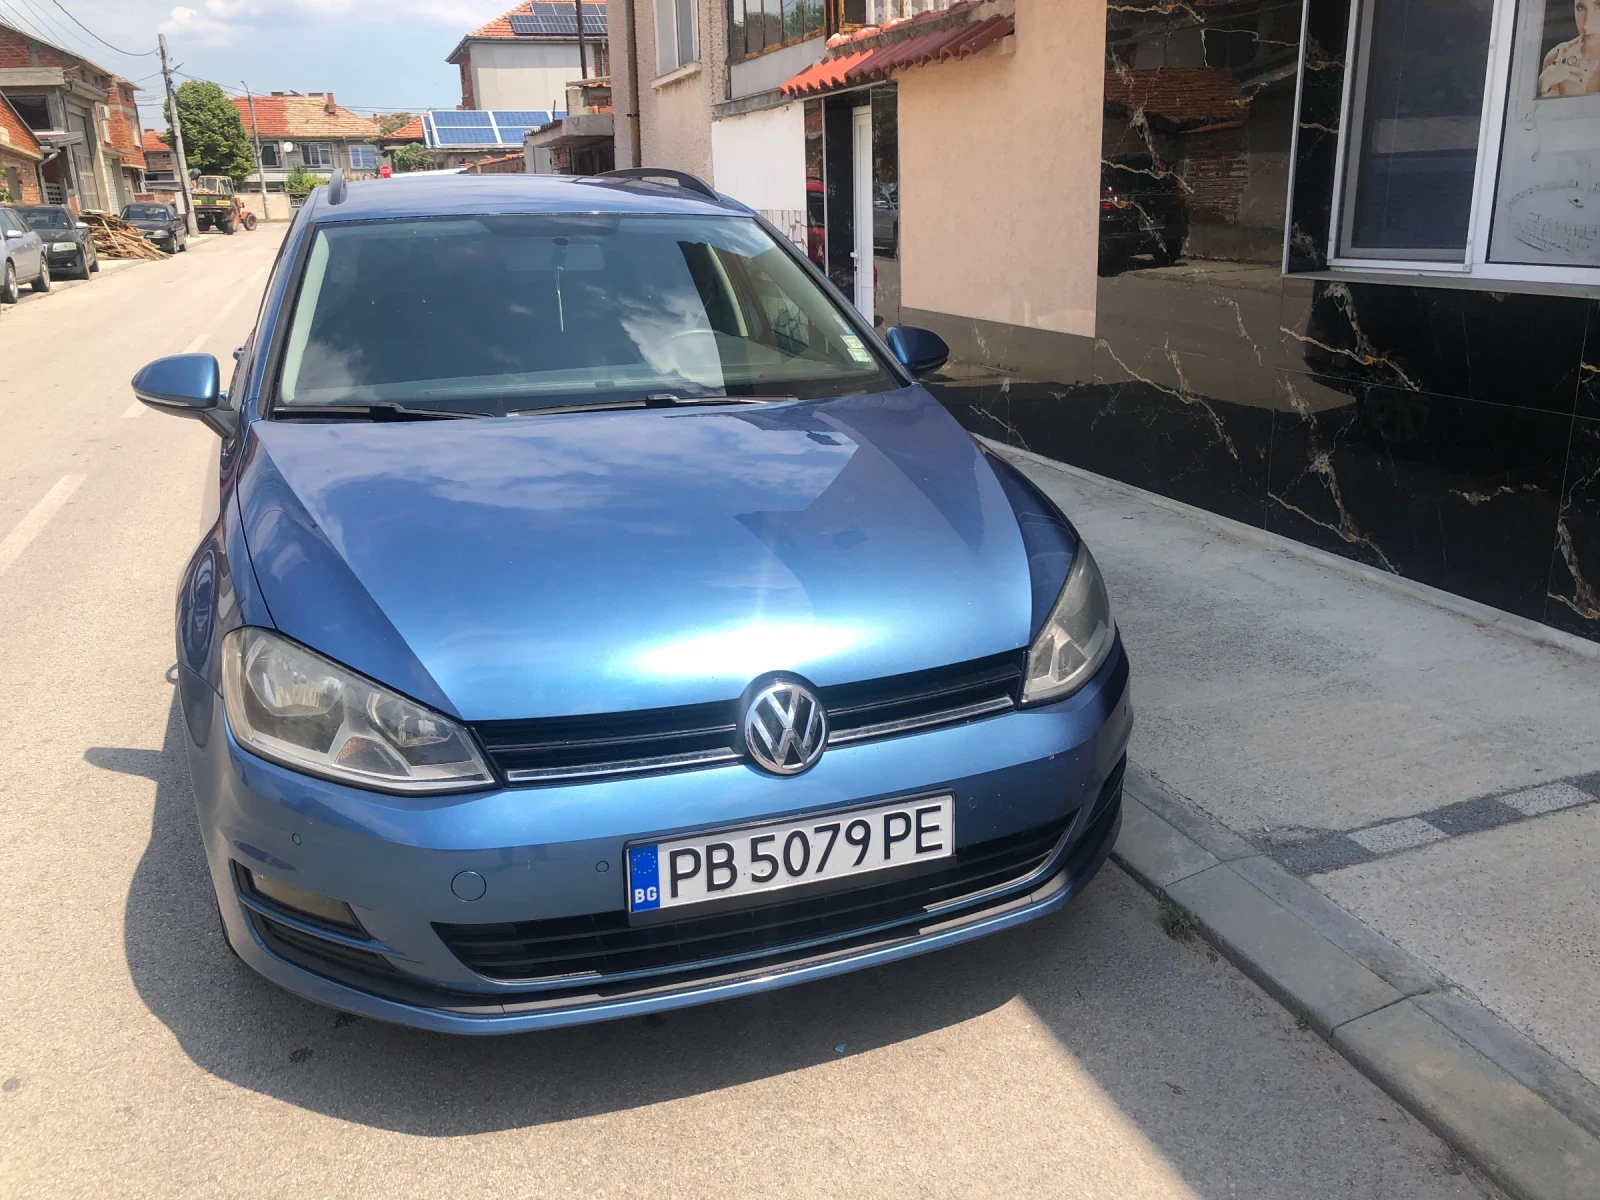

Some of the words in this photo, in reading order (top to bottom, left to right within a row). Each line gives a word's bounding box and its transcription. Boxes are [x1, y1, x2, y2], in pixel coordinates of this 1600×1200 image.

[746, 681, 825, 774] VW
[634, 886, 657, 903] BG
[669, 842, 738, 898] PB
[750, 819, 872, 883] 5079
[883, 805, 943, 860] PE
